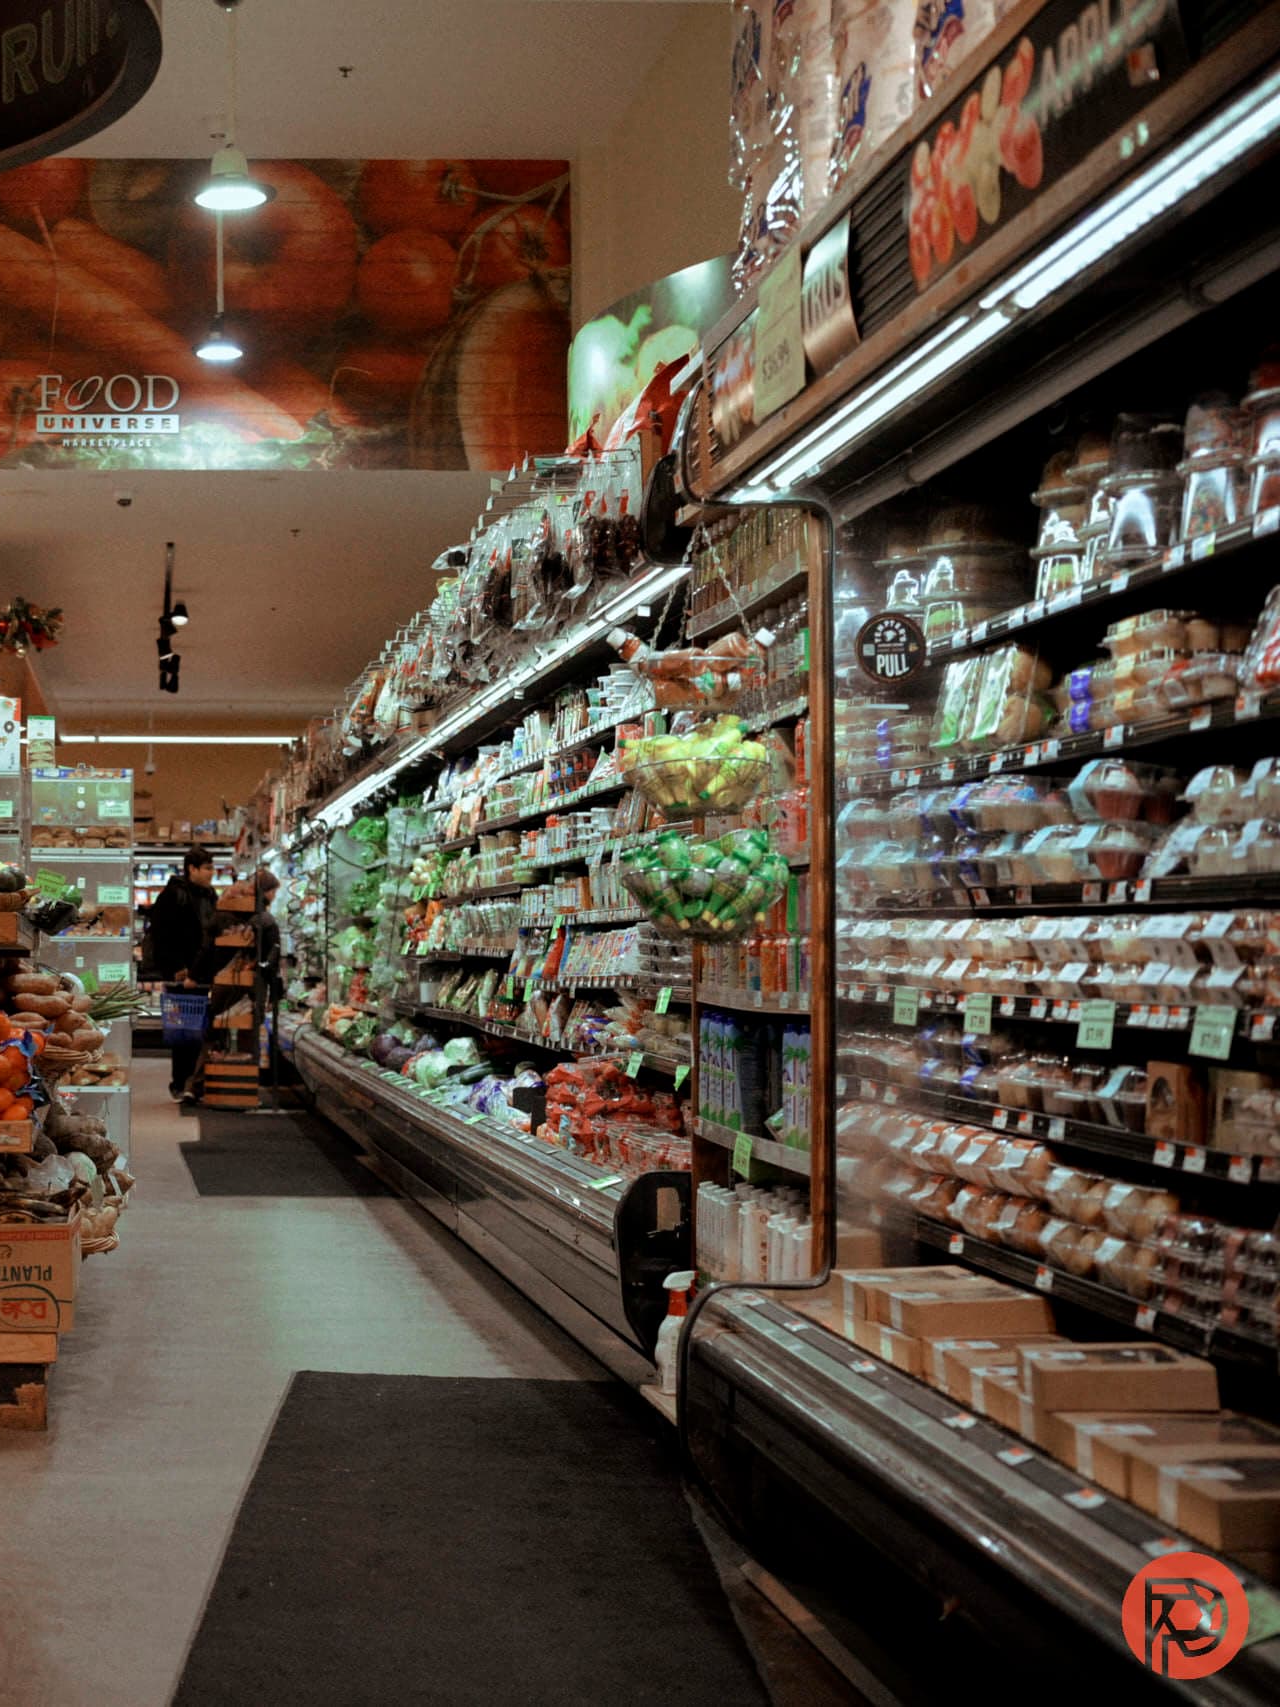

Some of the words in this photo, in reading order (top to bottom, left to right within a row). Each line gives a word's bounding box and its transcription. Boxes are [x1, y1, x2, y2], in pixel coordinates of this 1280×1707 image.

[36, 374, 180, 412] FOOD
[42, 416, 173, 431] UNIVERSE
[62, 438, 153, 449] MARKETPLACE
[876, 653, 910, 677] PULL
